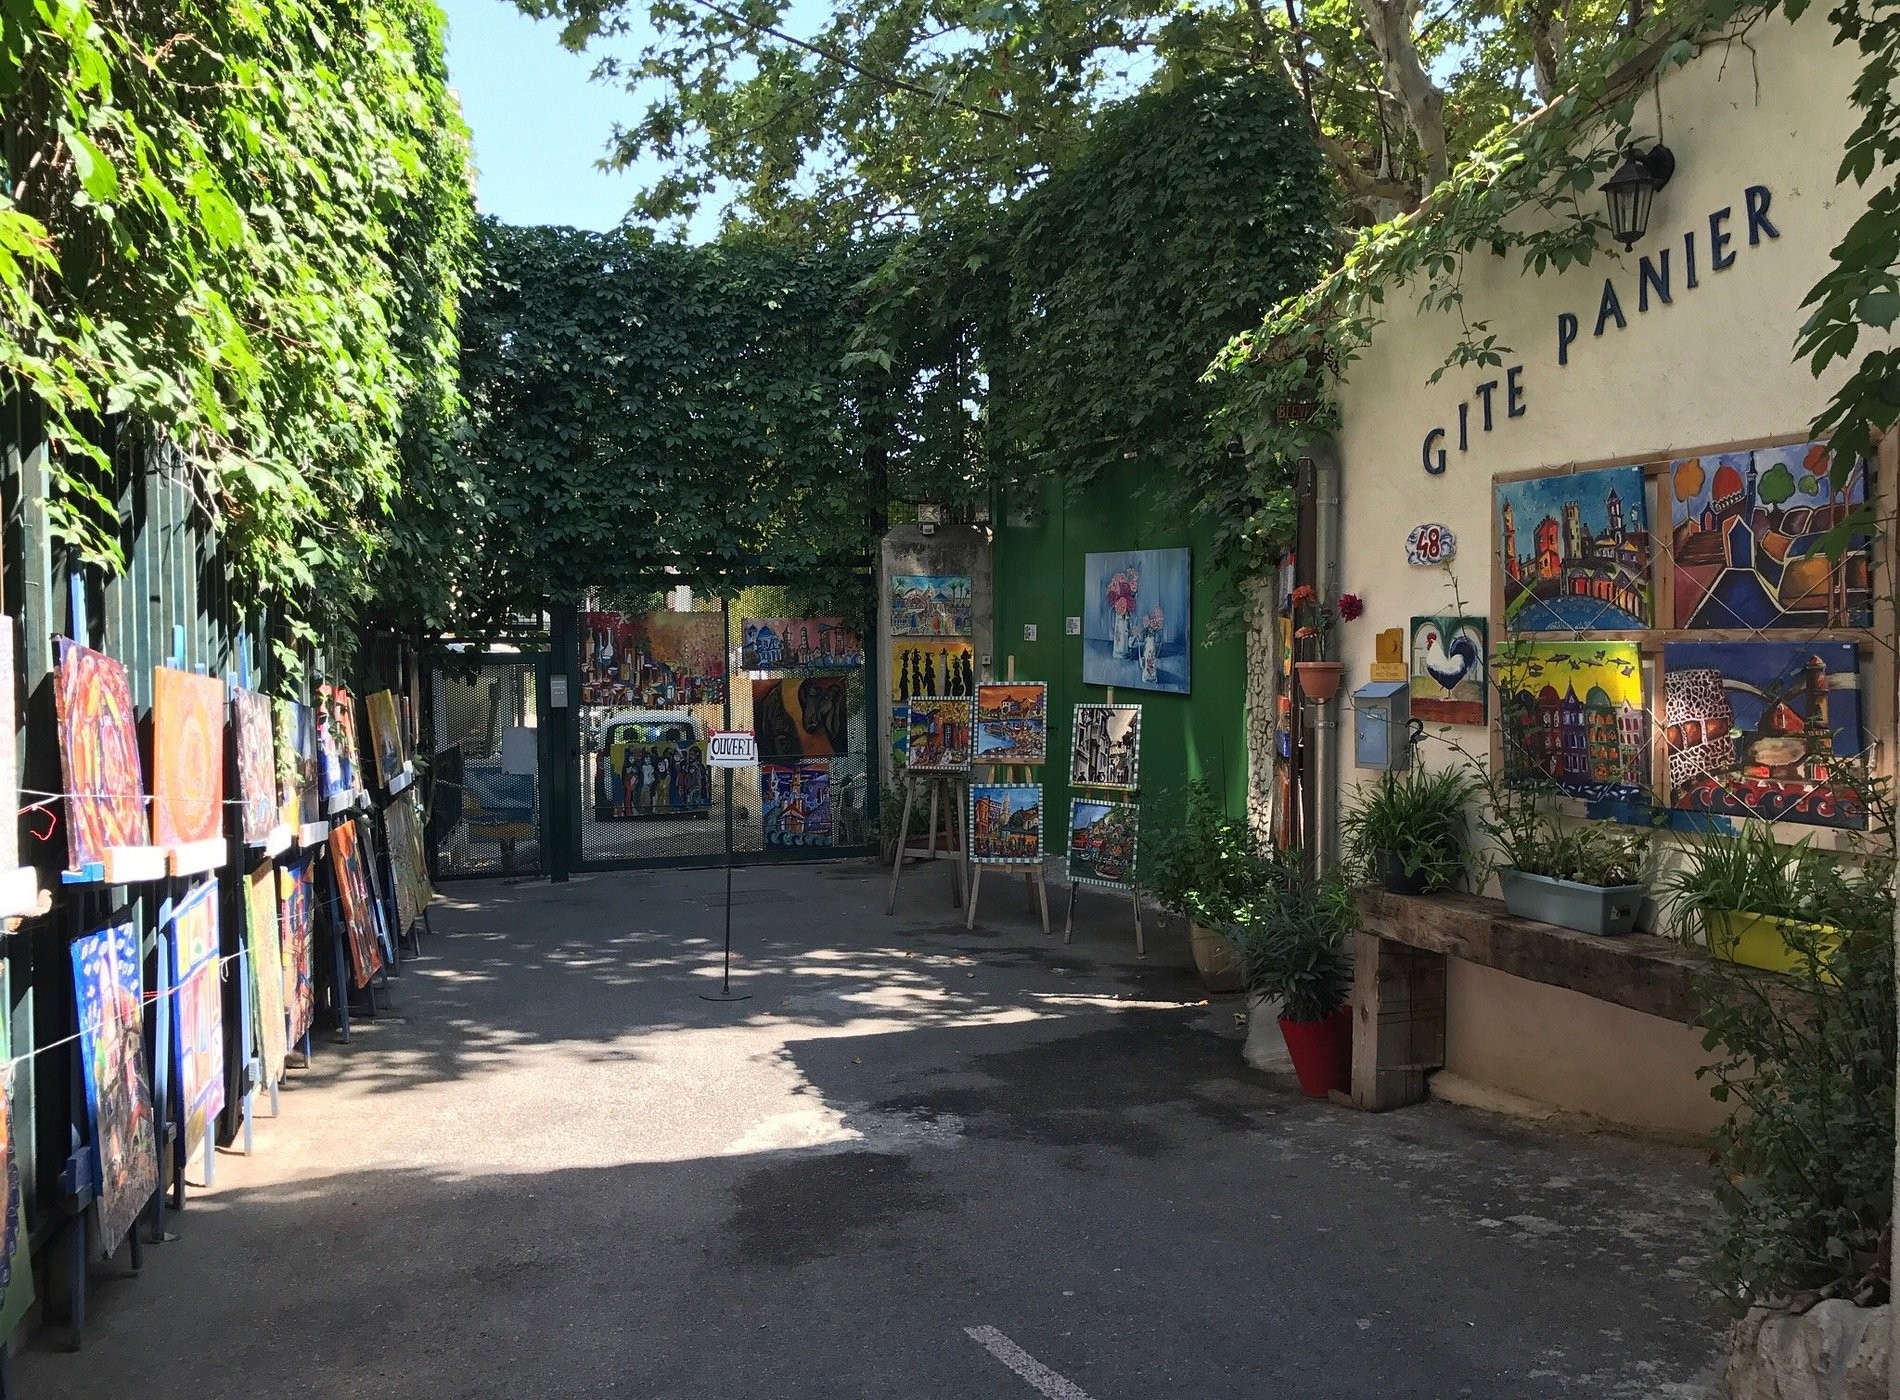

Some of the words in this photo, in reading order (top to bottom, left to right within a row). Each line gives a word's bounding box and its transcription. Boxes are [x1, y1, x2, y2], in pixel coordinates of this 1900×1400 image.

[1422, 366, 1526, 475] GITE
[1558, 185, 1780, 366] PANIER
[1416, 528, 1440, 558] 48
[712, 738, 752, 755] OUVERT
